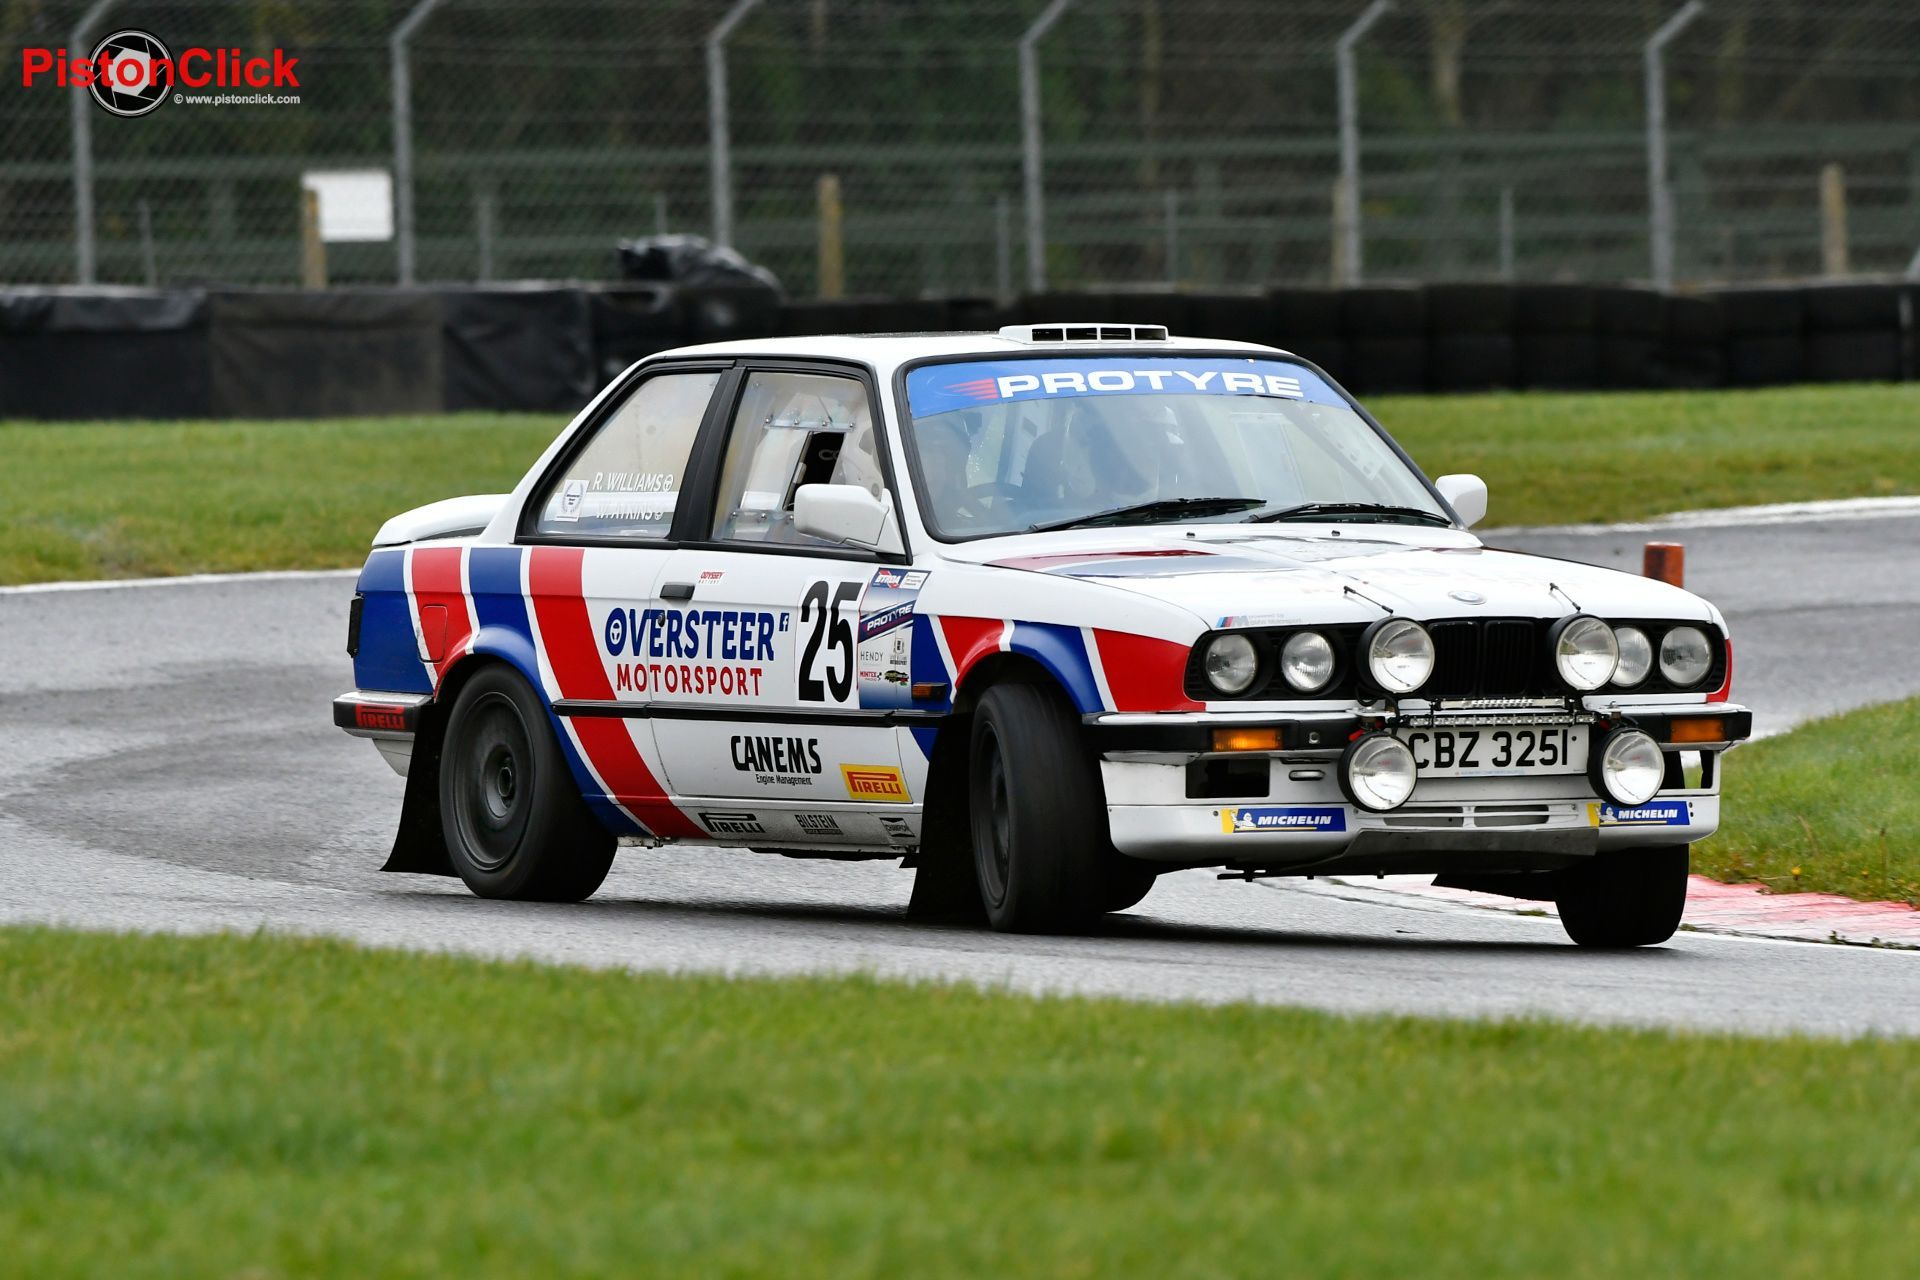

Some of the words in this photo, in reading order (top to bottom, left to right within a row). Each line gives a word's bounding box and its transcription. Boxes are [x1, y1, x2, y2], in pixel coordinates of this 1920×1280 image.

[997, 370, 1304, 398] PROTYRE
[592, 472, 603, 490] R.
[607, 473, 663, 491] WILLIAMS
[867, 604, 913, 632] PROTYRE
[605, 607, 774, 661] OVERSTEER
[798, 580, 863, 702] 25
[860, 650, 884, 662] HENDY
[616, 663, 763, 696] MOTORSPORT
[355, 703, 405, 729] PIRELLI
[730, 736, 822, 774] CANEMS
[1408, 731, 1480, 769] CBZ
[756, 774, 775, 786] Engine
[776, 775, 813, 787] Management
[847, 771, 902, 795] PIRELLI
[698, 812, 766, 833] PIRELLI
[794, 814, 840, 829] BILSTEIN
[1257, 815, 1332, 826] MICHELIN
[1617, 809, 1678, 819] MICHELIN
